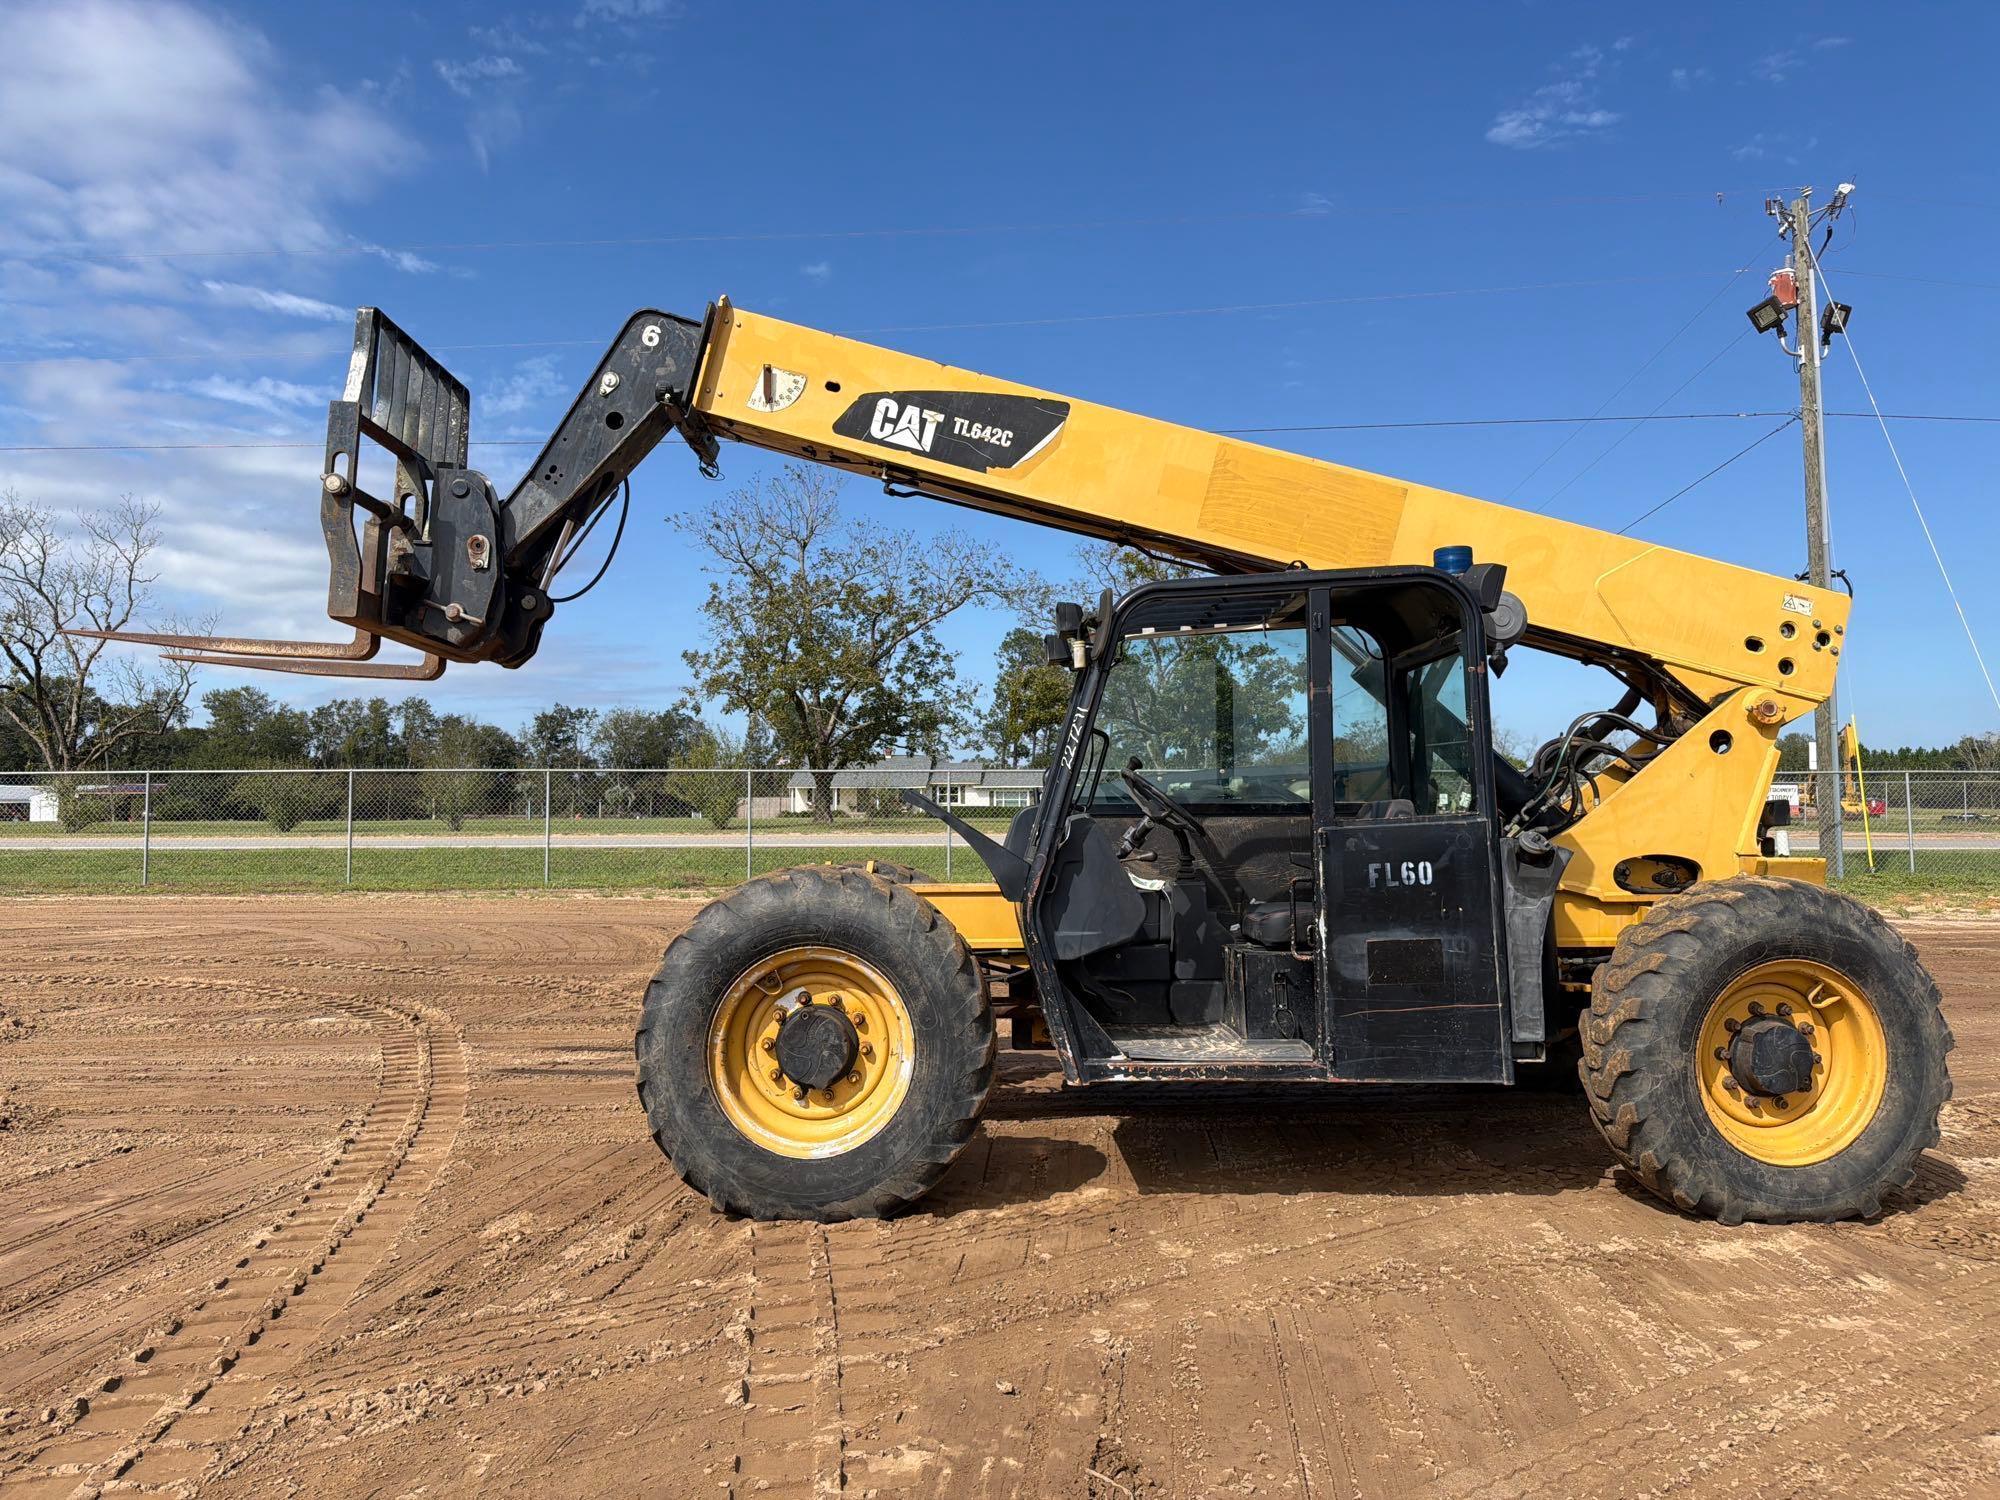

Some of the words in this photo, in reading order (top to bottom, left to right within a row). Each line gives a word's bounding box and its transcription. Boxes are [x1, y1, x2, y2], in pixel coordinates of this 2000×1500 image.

[642, 325, 661, 346] 6
[870, 398, 944, 453] CAT
[953, 416, 1014, 448] TL642C
[1368, 861, 1433, 888] FL60
